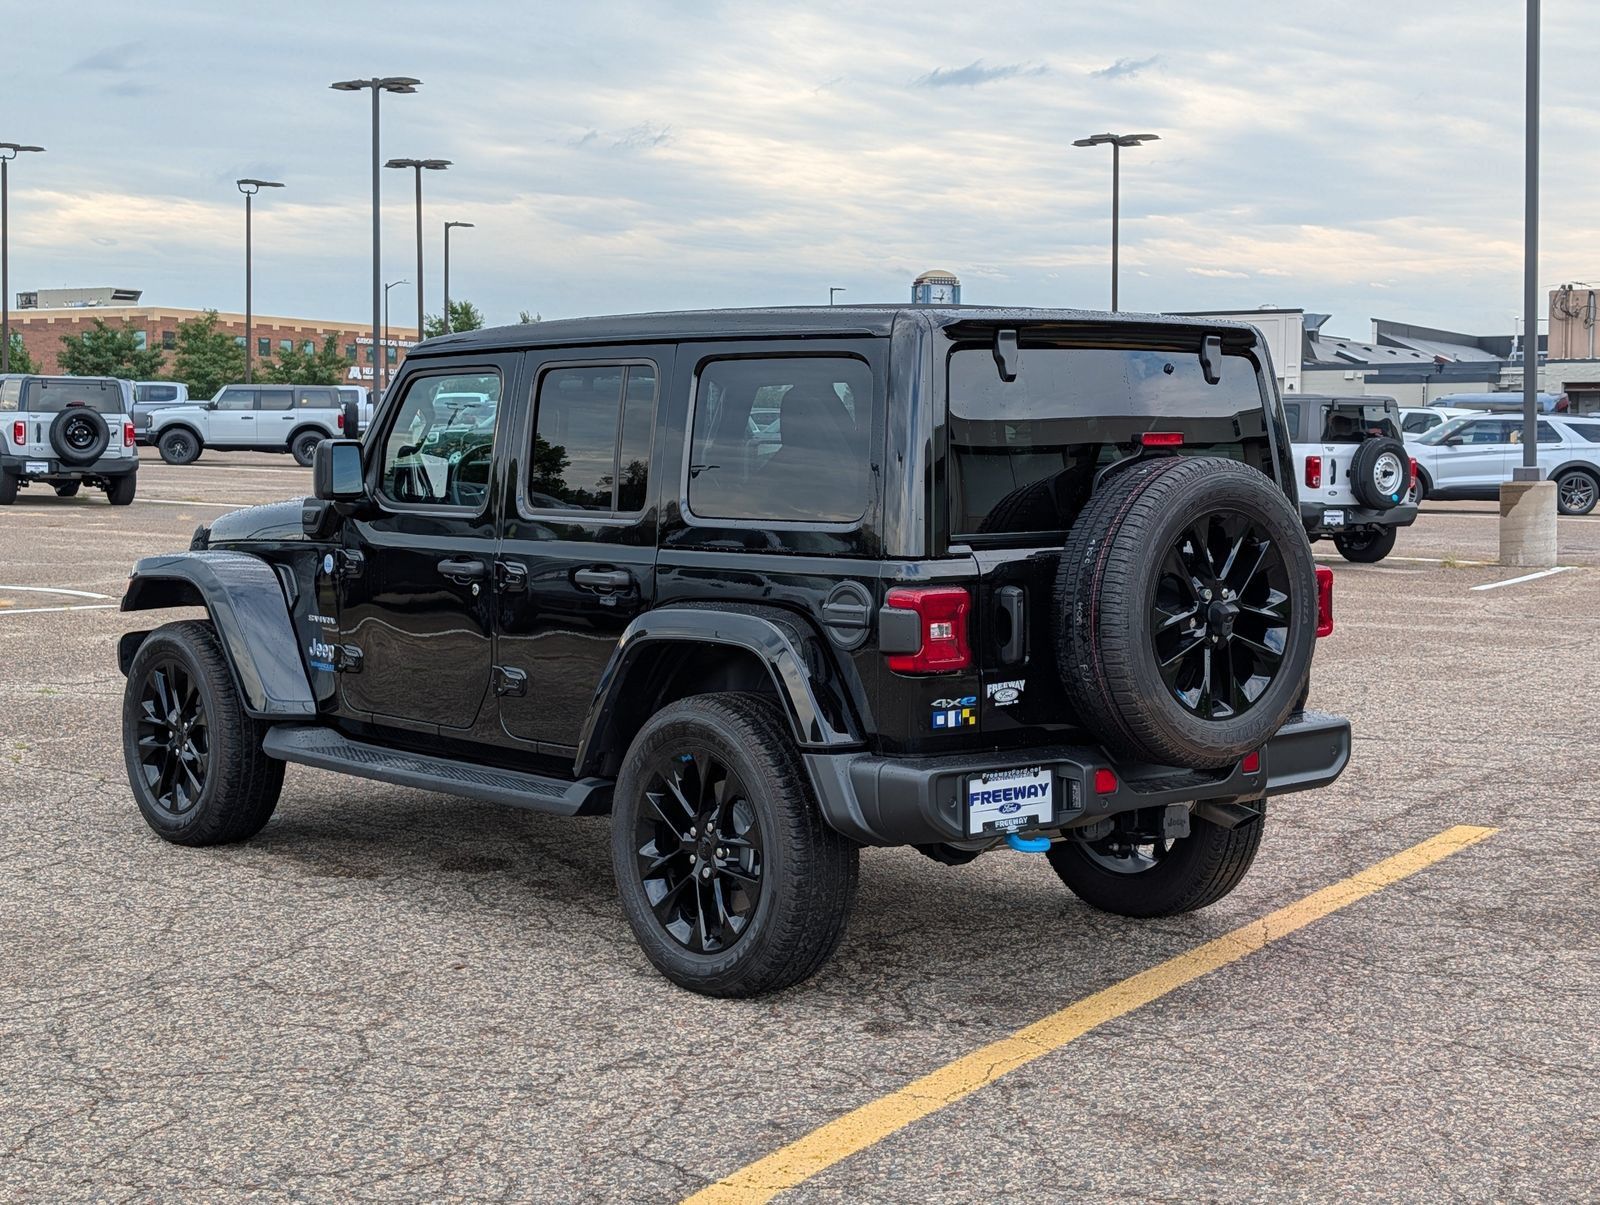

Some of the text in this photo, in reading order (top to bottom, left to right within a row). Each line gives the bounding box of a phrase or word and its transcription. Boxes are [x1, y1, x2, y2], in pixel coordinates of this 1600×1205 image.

[309, 638, 335, 662] Jeep
[986, 679, 1026, 699] FREEWAY
[968, 783, 1050, 807] FREEWAY
[995, 816, 1028, 829] FREEWAY
